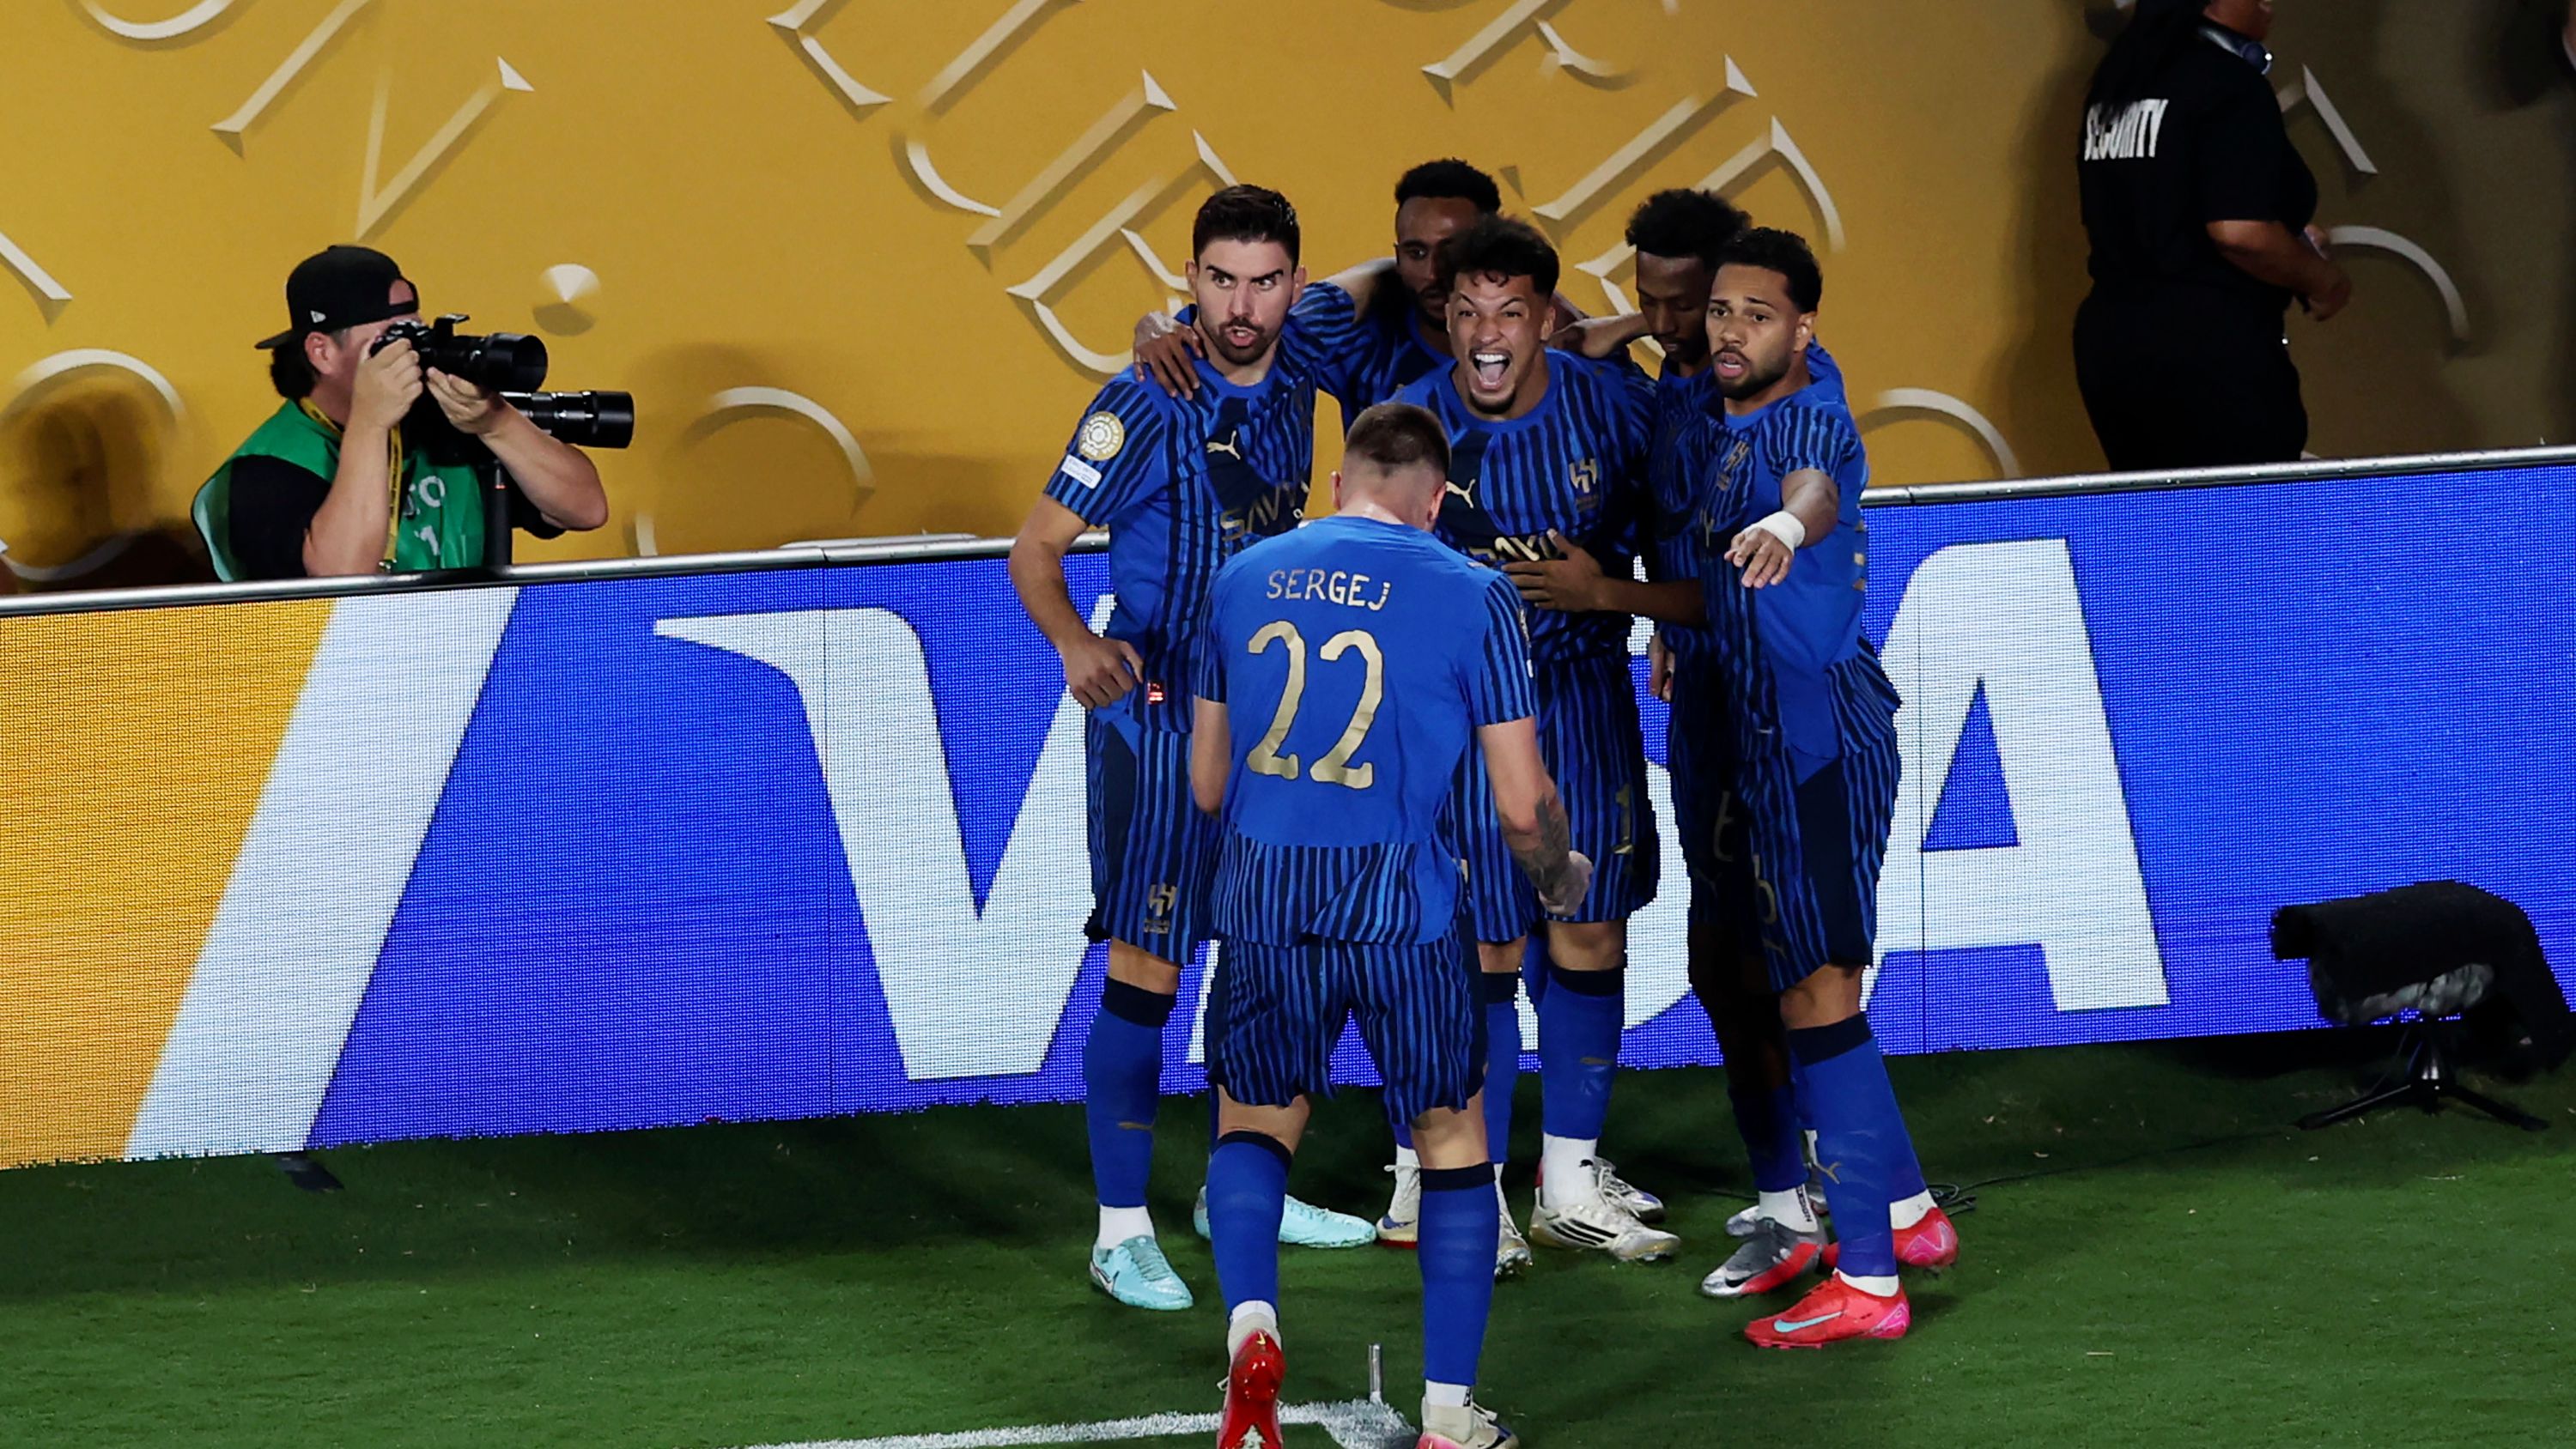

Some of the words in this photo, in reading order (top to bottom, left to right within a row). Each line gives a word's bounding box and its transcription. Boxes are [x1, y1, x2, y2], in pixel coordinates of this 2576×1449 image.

[1266, 568, 1391, 611] SERGEJ
[1246, 620, 1385, 790] 22
[653, 537, 2170, 1081] VA
